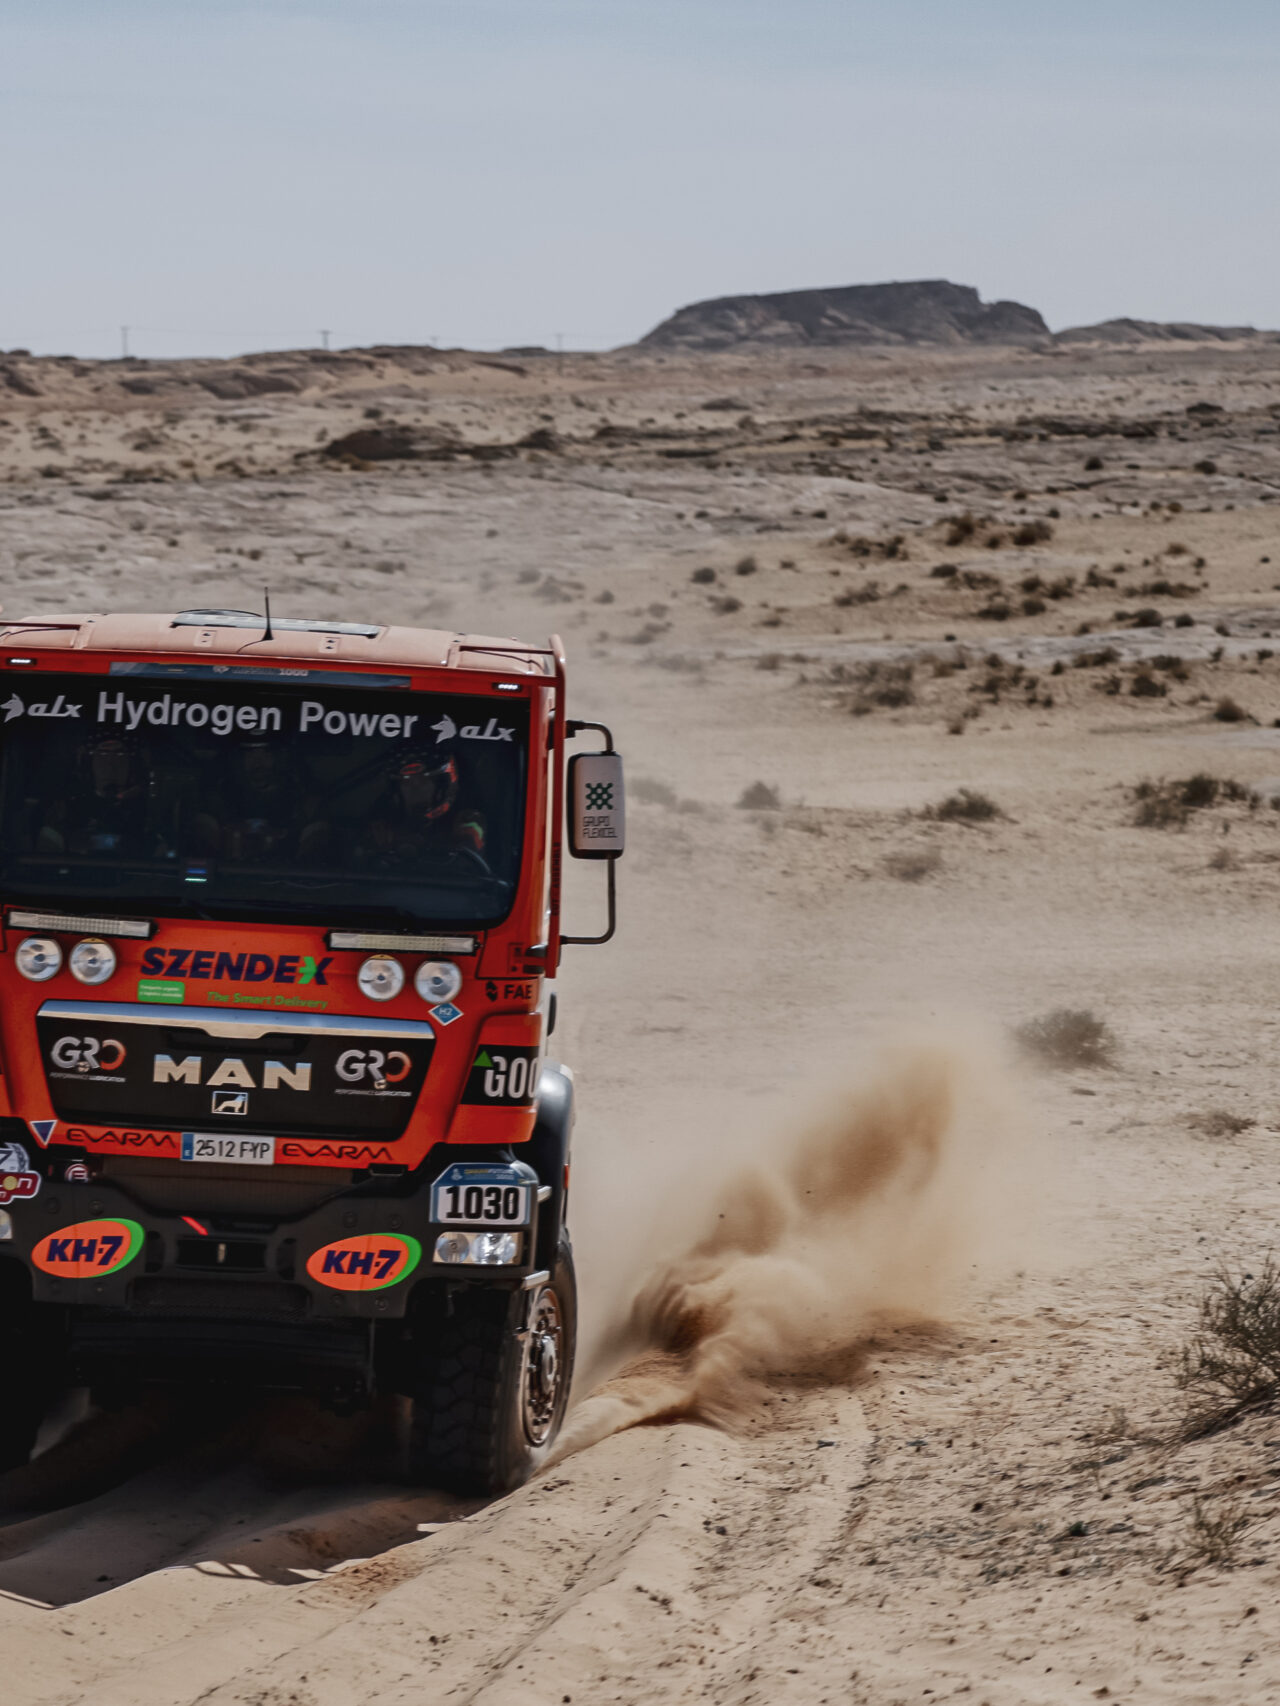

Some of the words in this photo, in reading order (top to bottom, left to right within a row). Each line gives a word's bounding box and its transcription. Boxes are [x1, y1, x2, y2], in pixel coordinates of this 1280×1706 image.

[97, 692, 281, 735] Hydrogen
[299, 701, 418, 738] Power
[140, 947, 334, 985] SZENDEX
[207, 991, 230, 1002] The
[233, 993, 272, 1004] Smart
[275, 995, 328, 1010] Delivery
[504, 984, 533, 999] FAE
[50, 1036, 126, 1071] GRO
[335, 1049, 412, 1083] GRO
[153, 1054, 312, 1091] MAN
[66, 1128, 176, 1148] EVARM
[195, 1140, 235, 1157] 2512
[240, 1141, 271, 1158] FYP
[282, 1143, 393, 1161] EVARM
[445, 1186, 519, 1220] 1030
